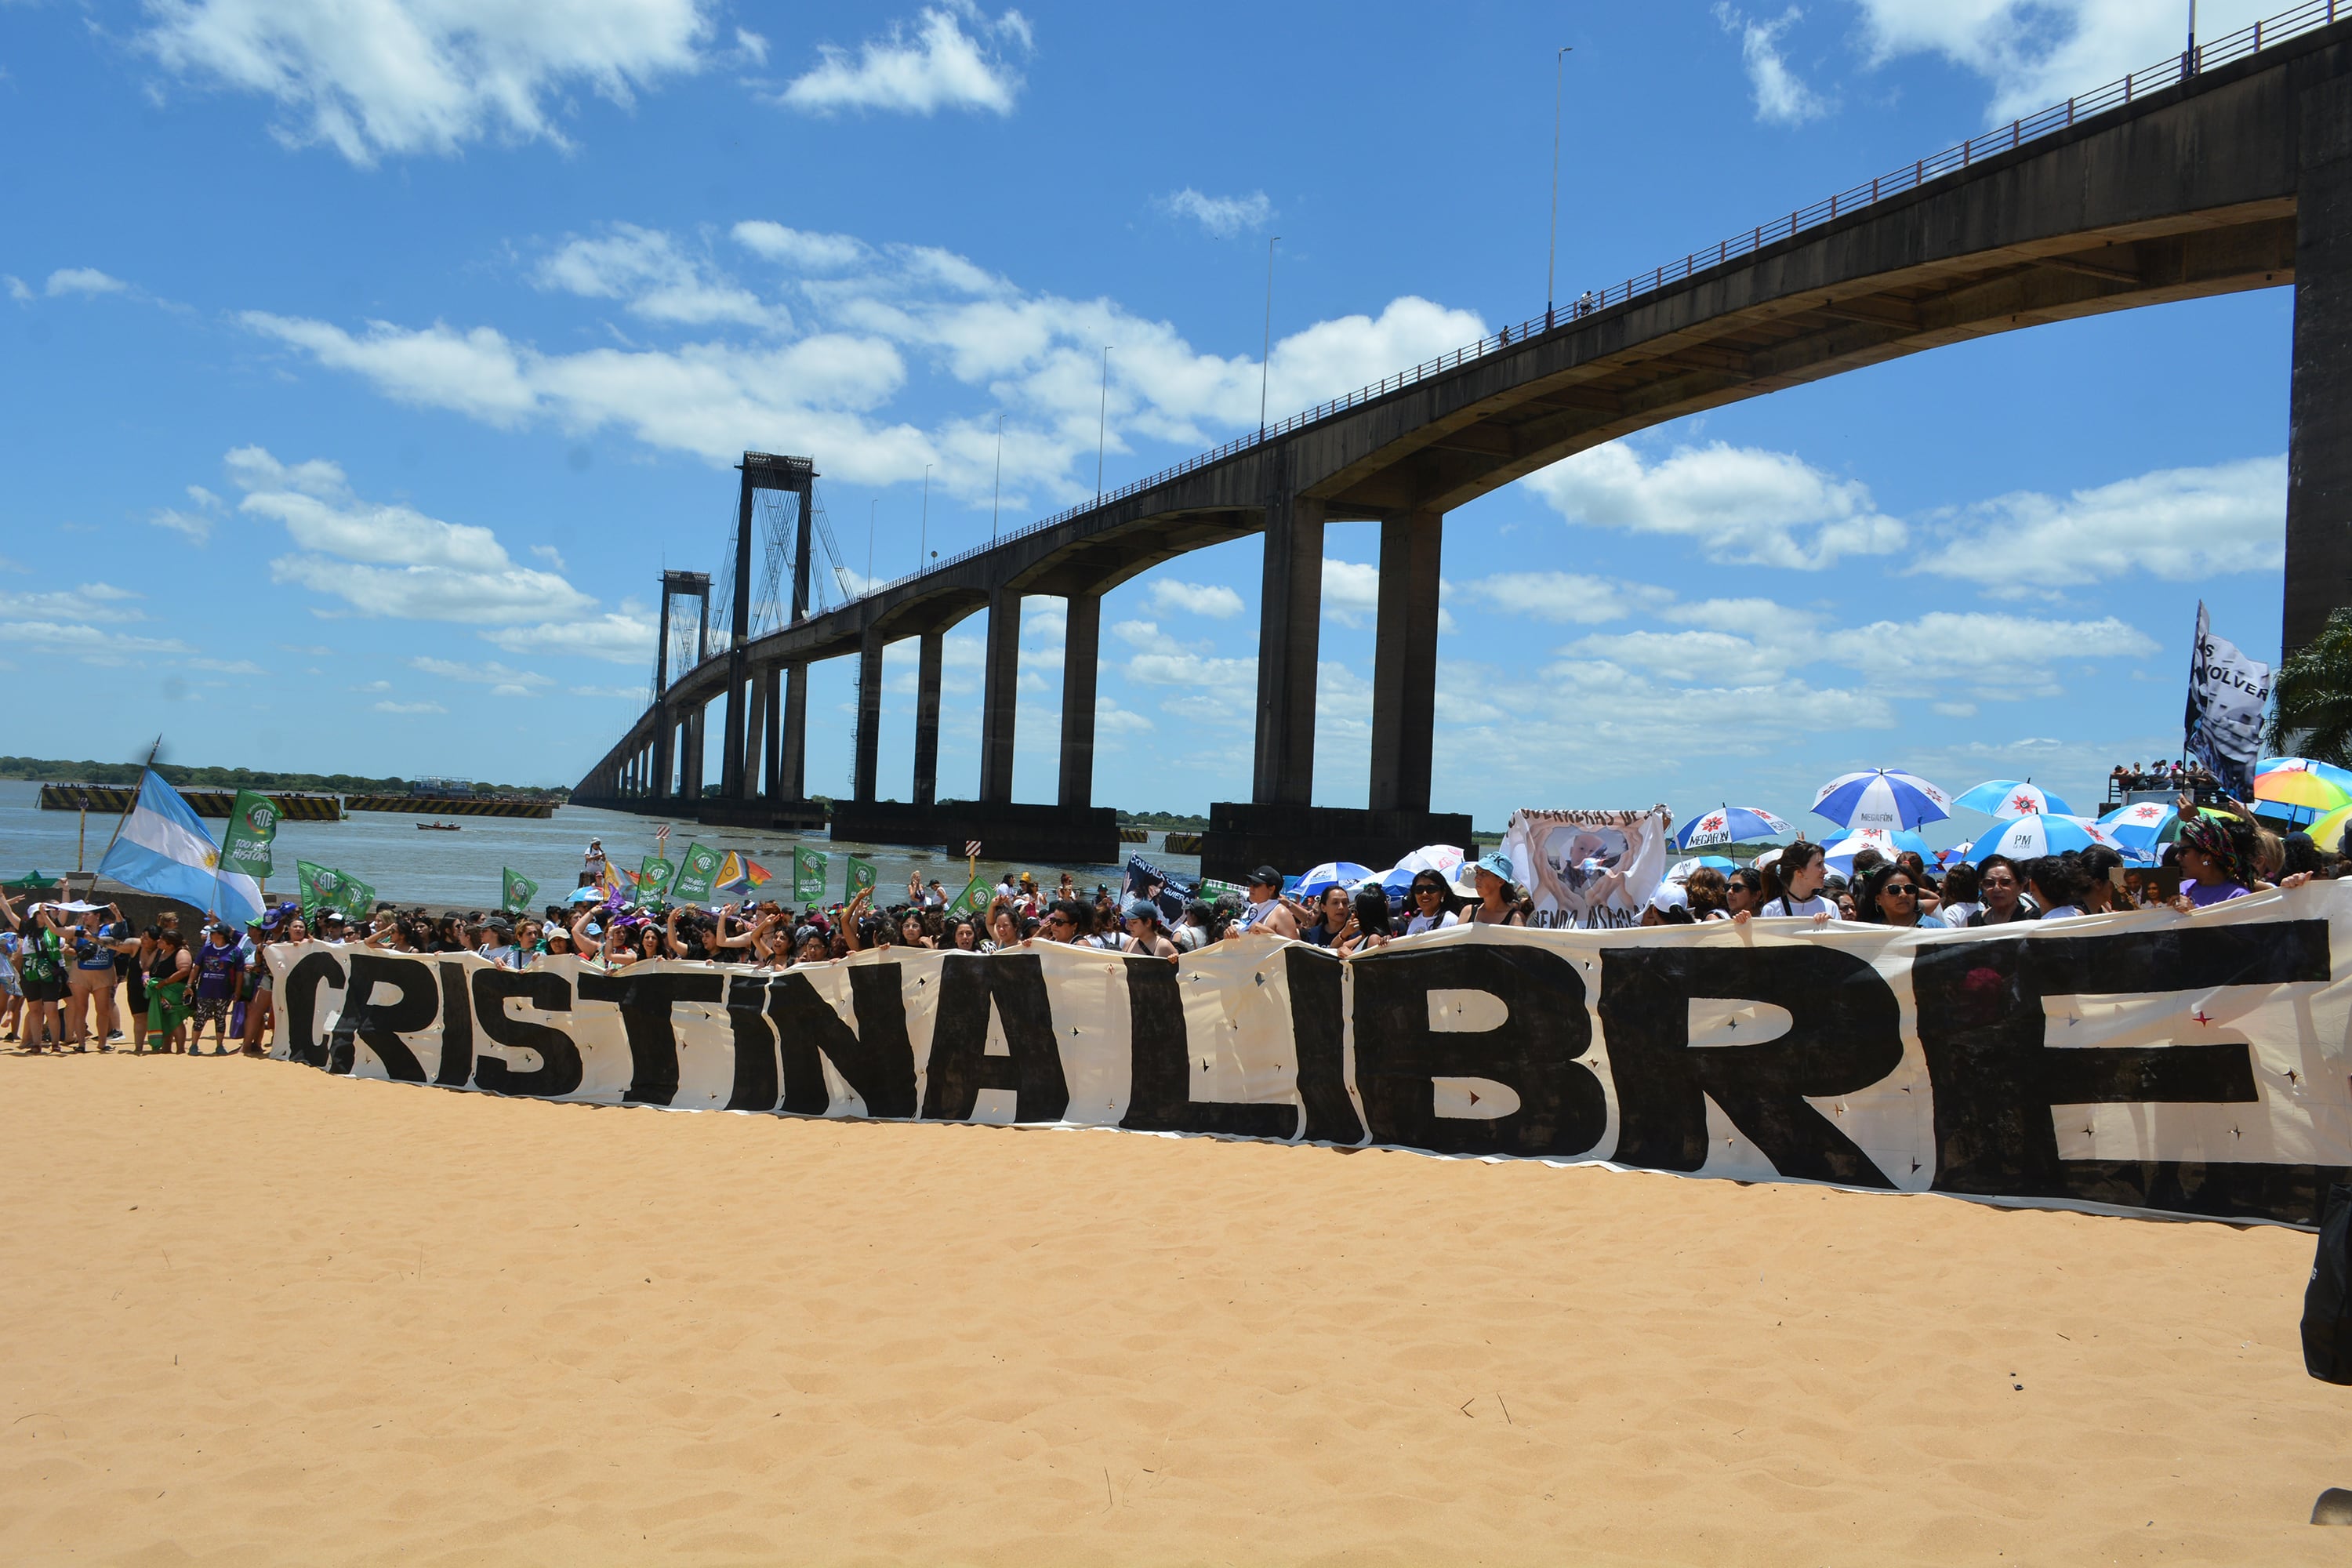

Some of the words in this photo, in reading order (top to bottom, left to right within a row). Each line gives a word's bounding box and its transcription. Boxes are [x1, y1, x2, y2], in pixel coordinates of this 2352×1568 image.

[254, 809, 274, 827] ATE
[251, 840, 270, 852] AÑO
[2014, 835, 2032, 844] PM
[698, 856, 711, 869] ATE
[320, 872, 337, 890] ATE
[285, 952, 1069, 1122] CRISTINA
[1118, 920, 2352, 1224] LIBRE
